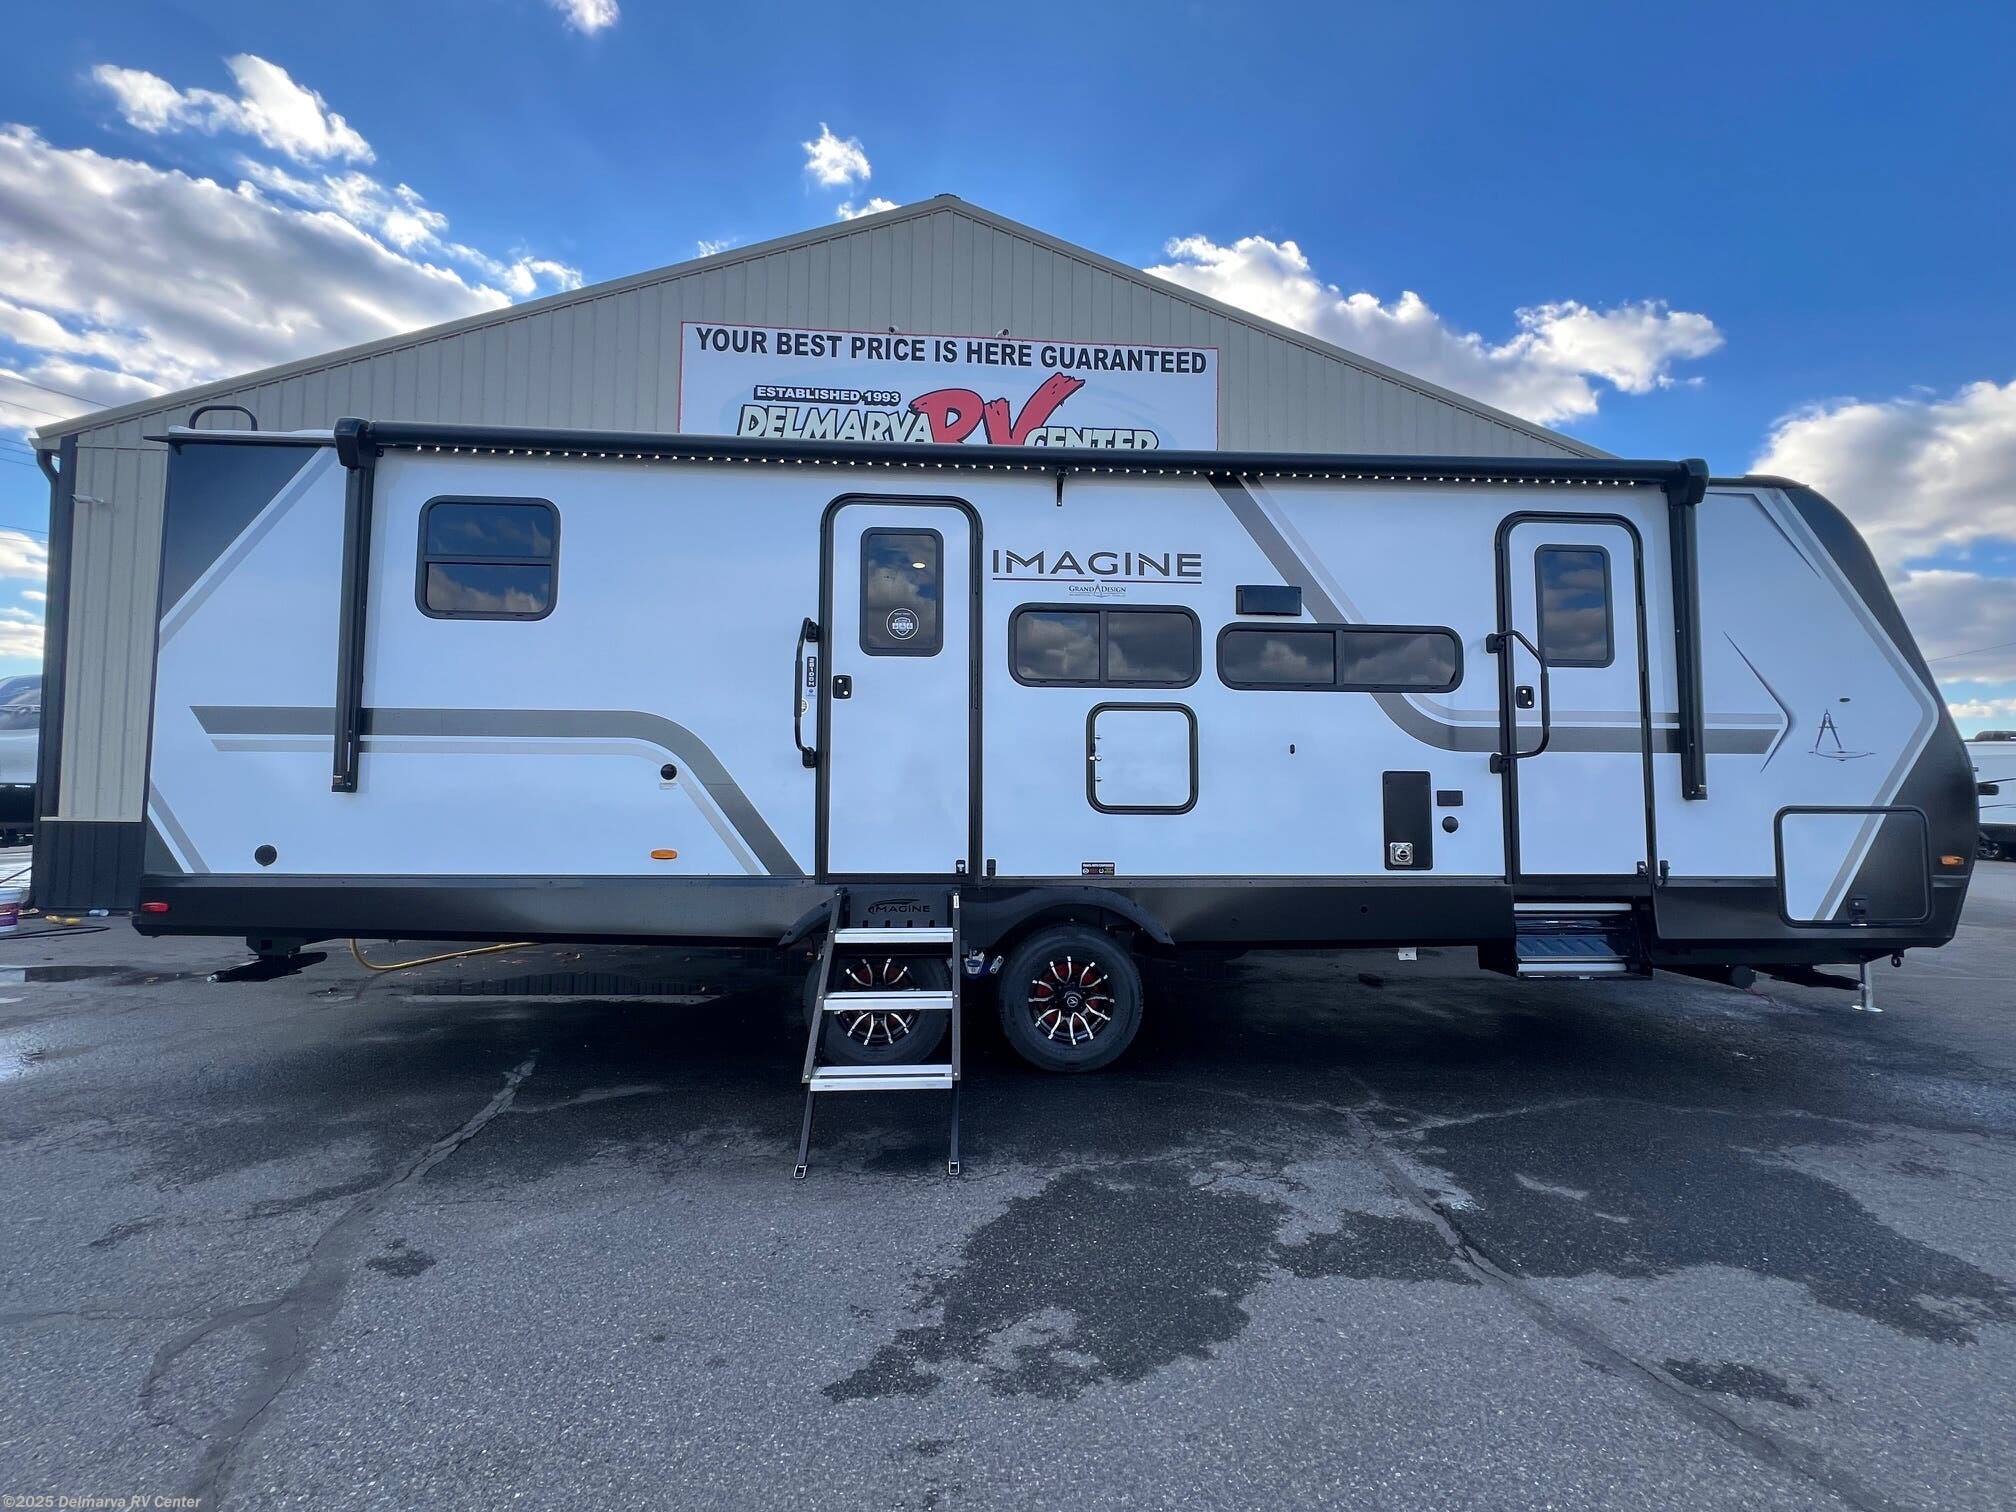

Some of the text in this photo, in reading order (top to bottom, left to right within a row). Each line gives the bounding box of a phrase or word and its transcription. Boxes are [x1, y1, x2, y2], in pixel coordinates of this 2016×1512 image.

[696, 327, 1207, 374] YOUR BEST PRICE IS HERE GUARANTEED
[738, 372, 1159, 449] DELMARVA RV CENTER
[756, 386, 900, 403] ESTABLISHED 1993
[992, 549, 1202, 577] IMAGINE
